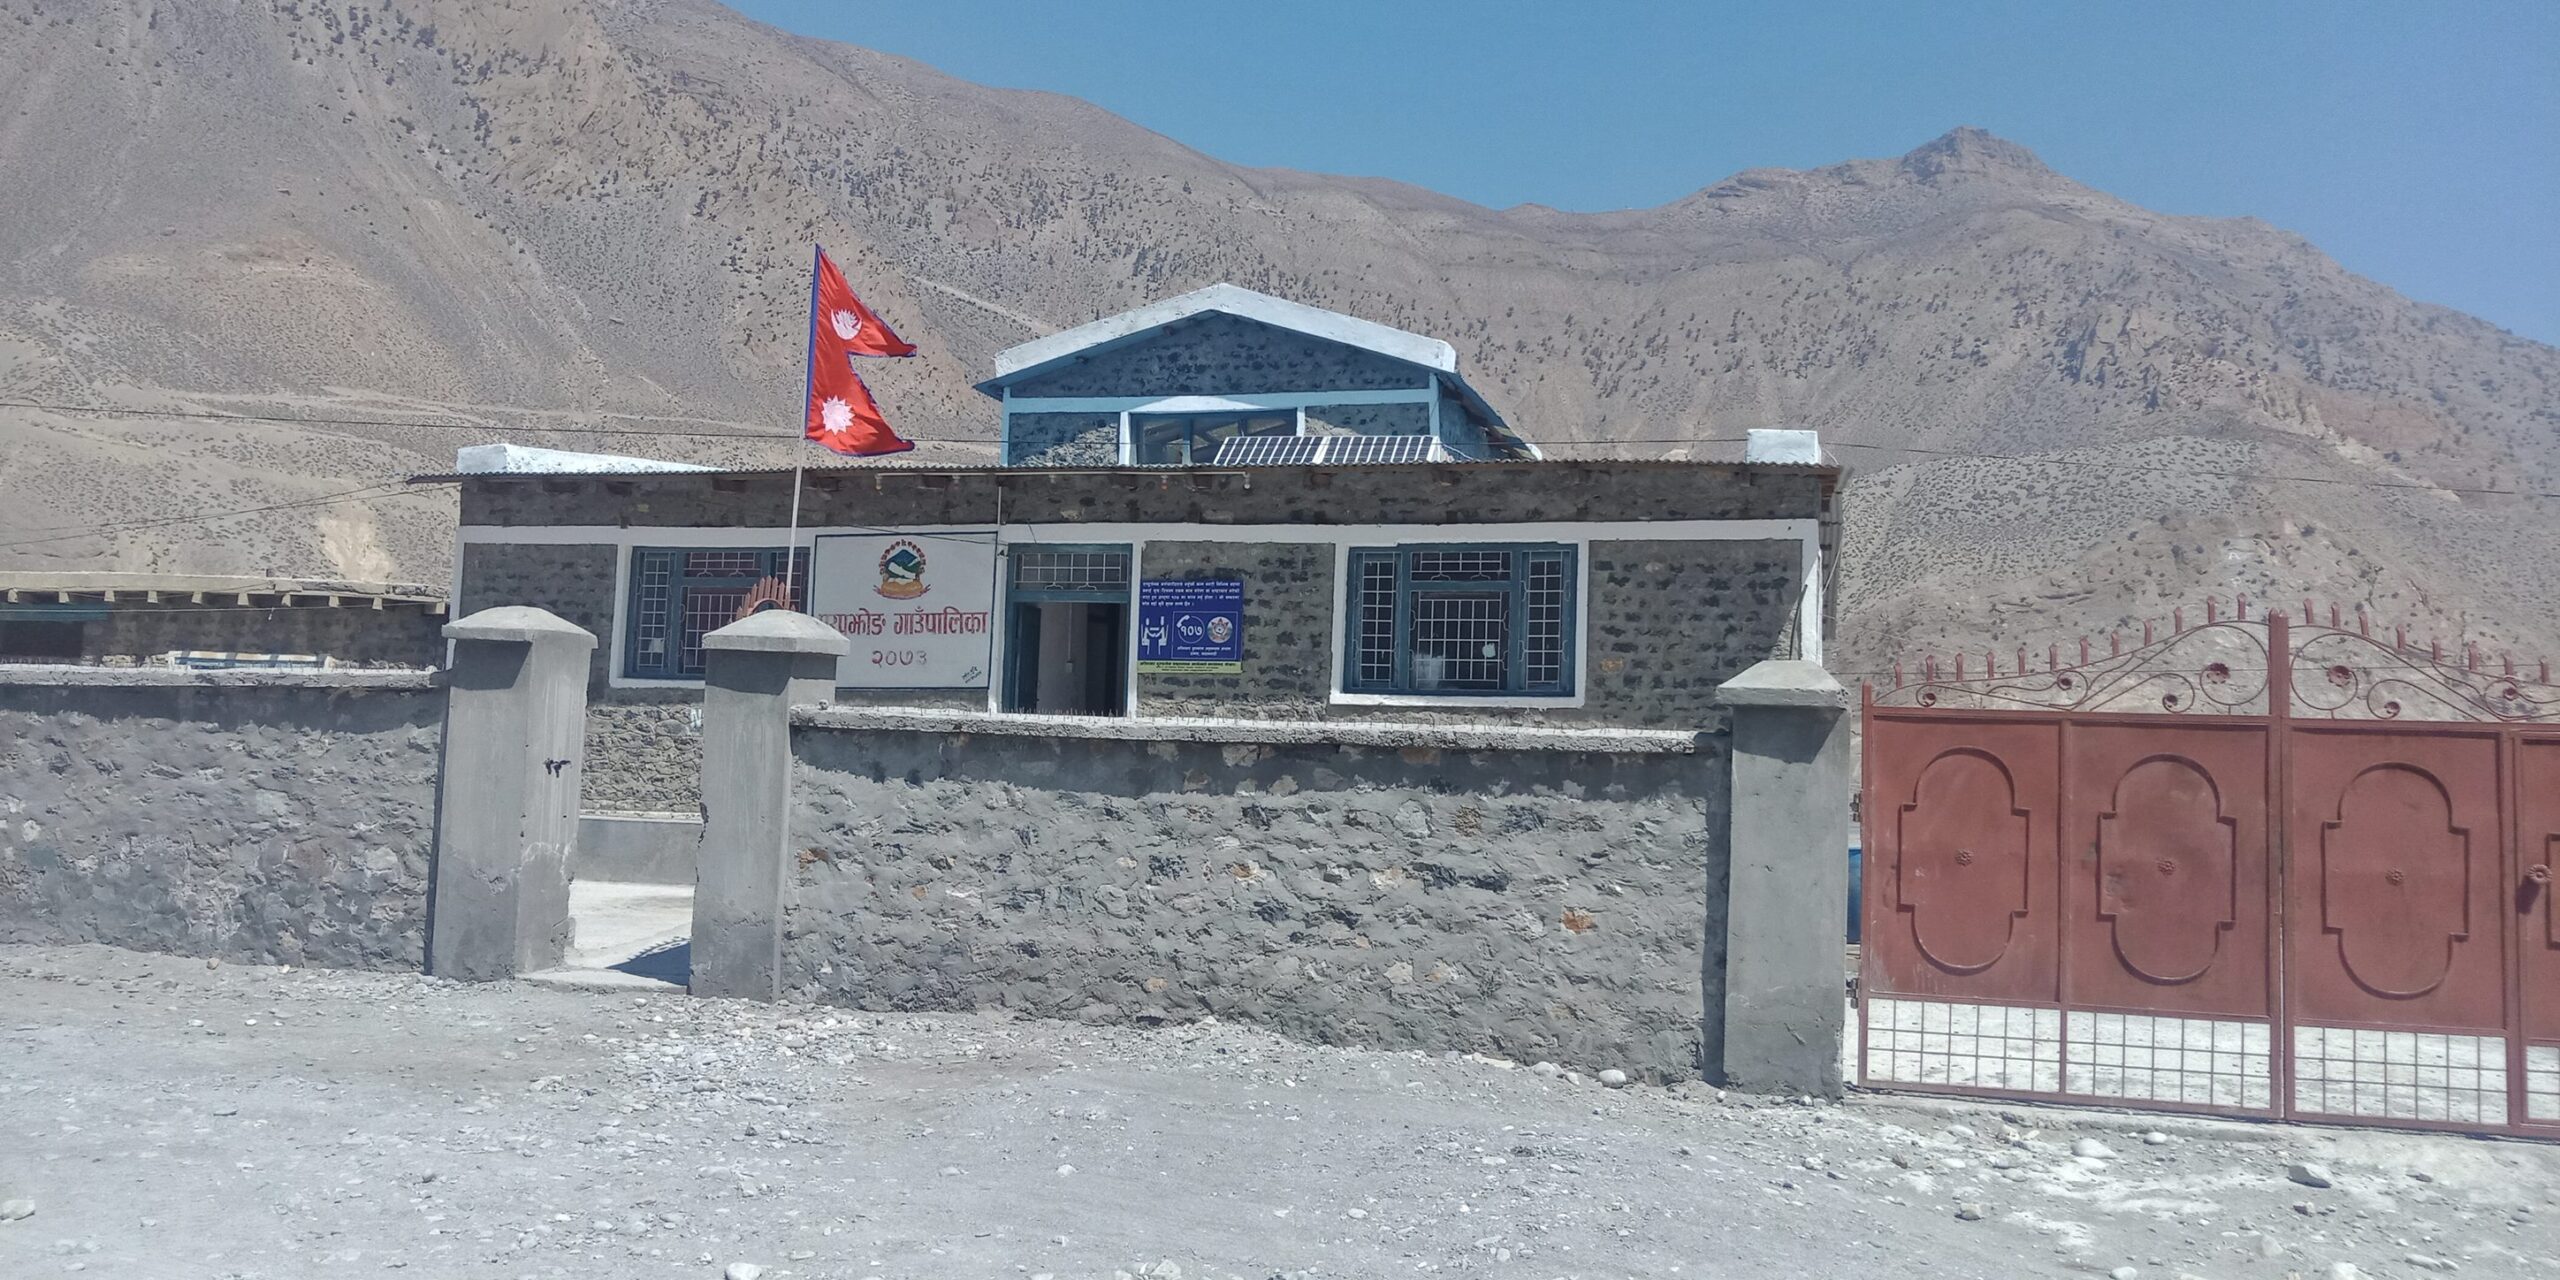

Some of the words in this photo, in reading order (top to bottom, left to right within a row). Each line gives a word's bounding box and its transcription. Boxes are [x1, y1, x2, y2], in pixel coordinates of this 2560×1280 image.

[894, 605, 988, 635] गाउँपालिका
[1180, 625, 1203, 636] १०७
[872, 650, 927, 668] २०७३
